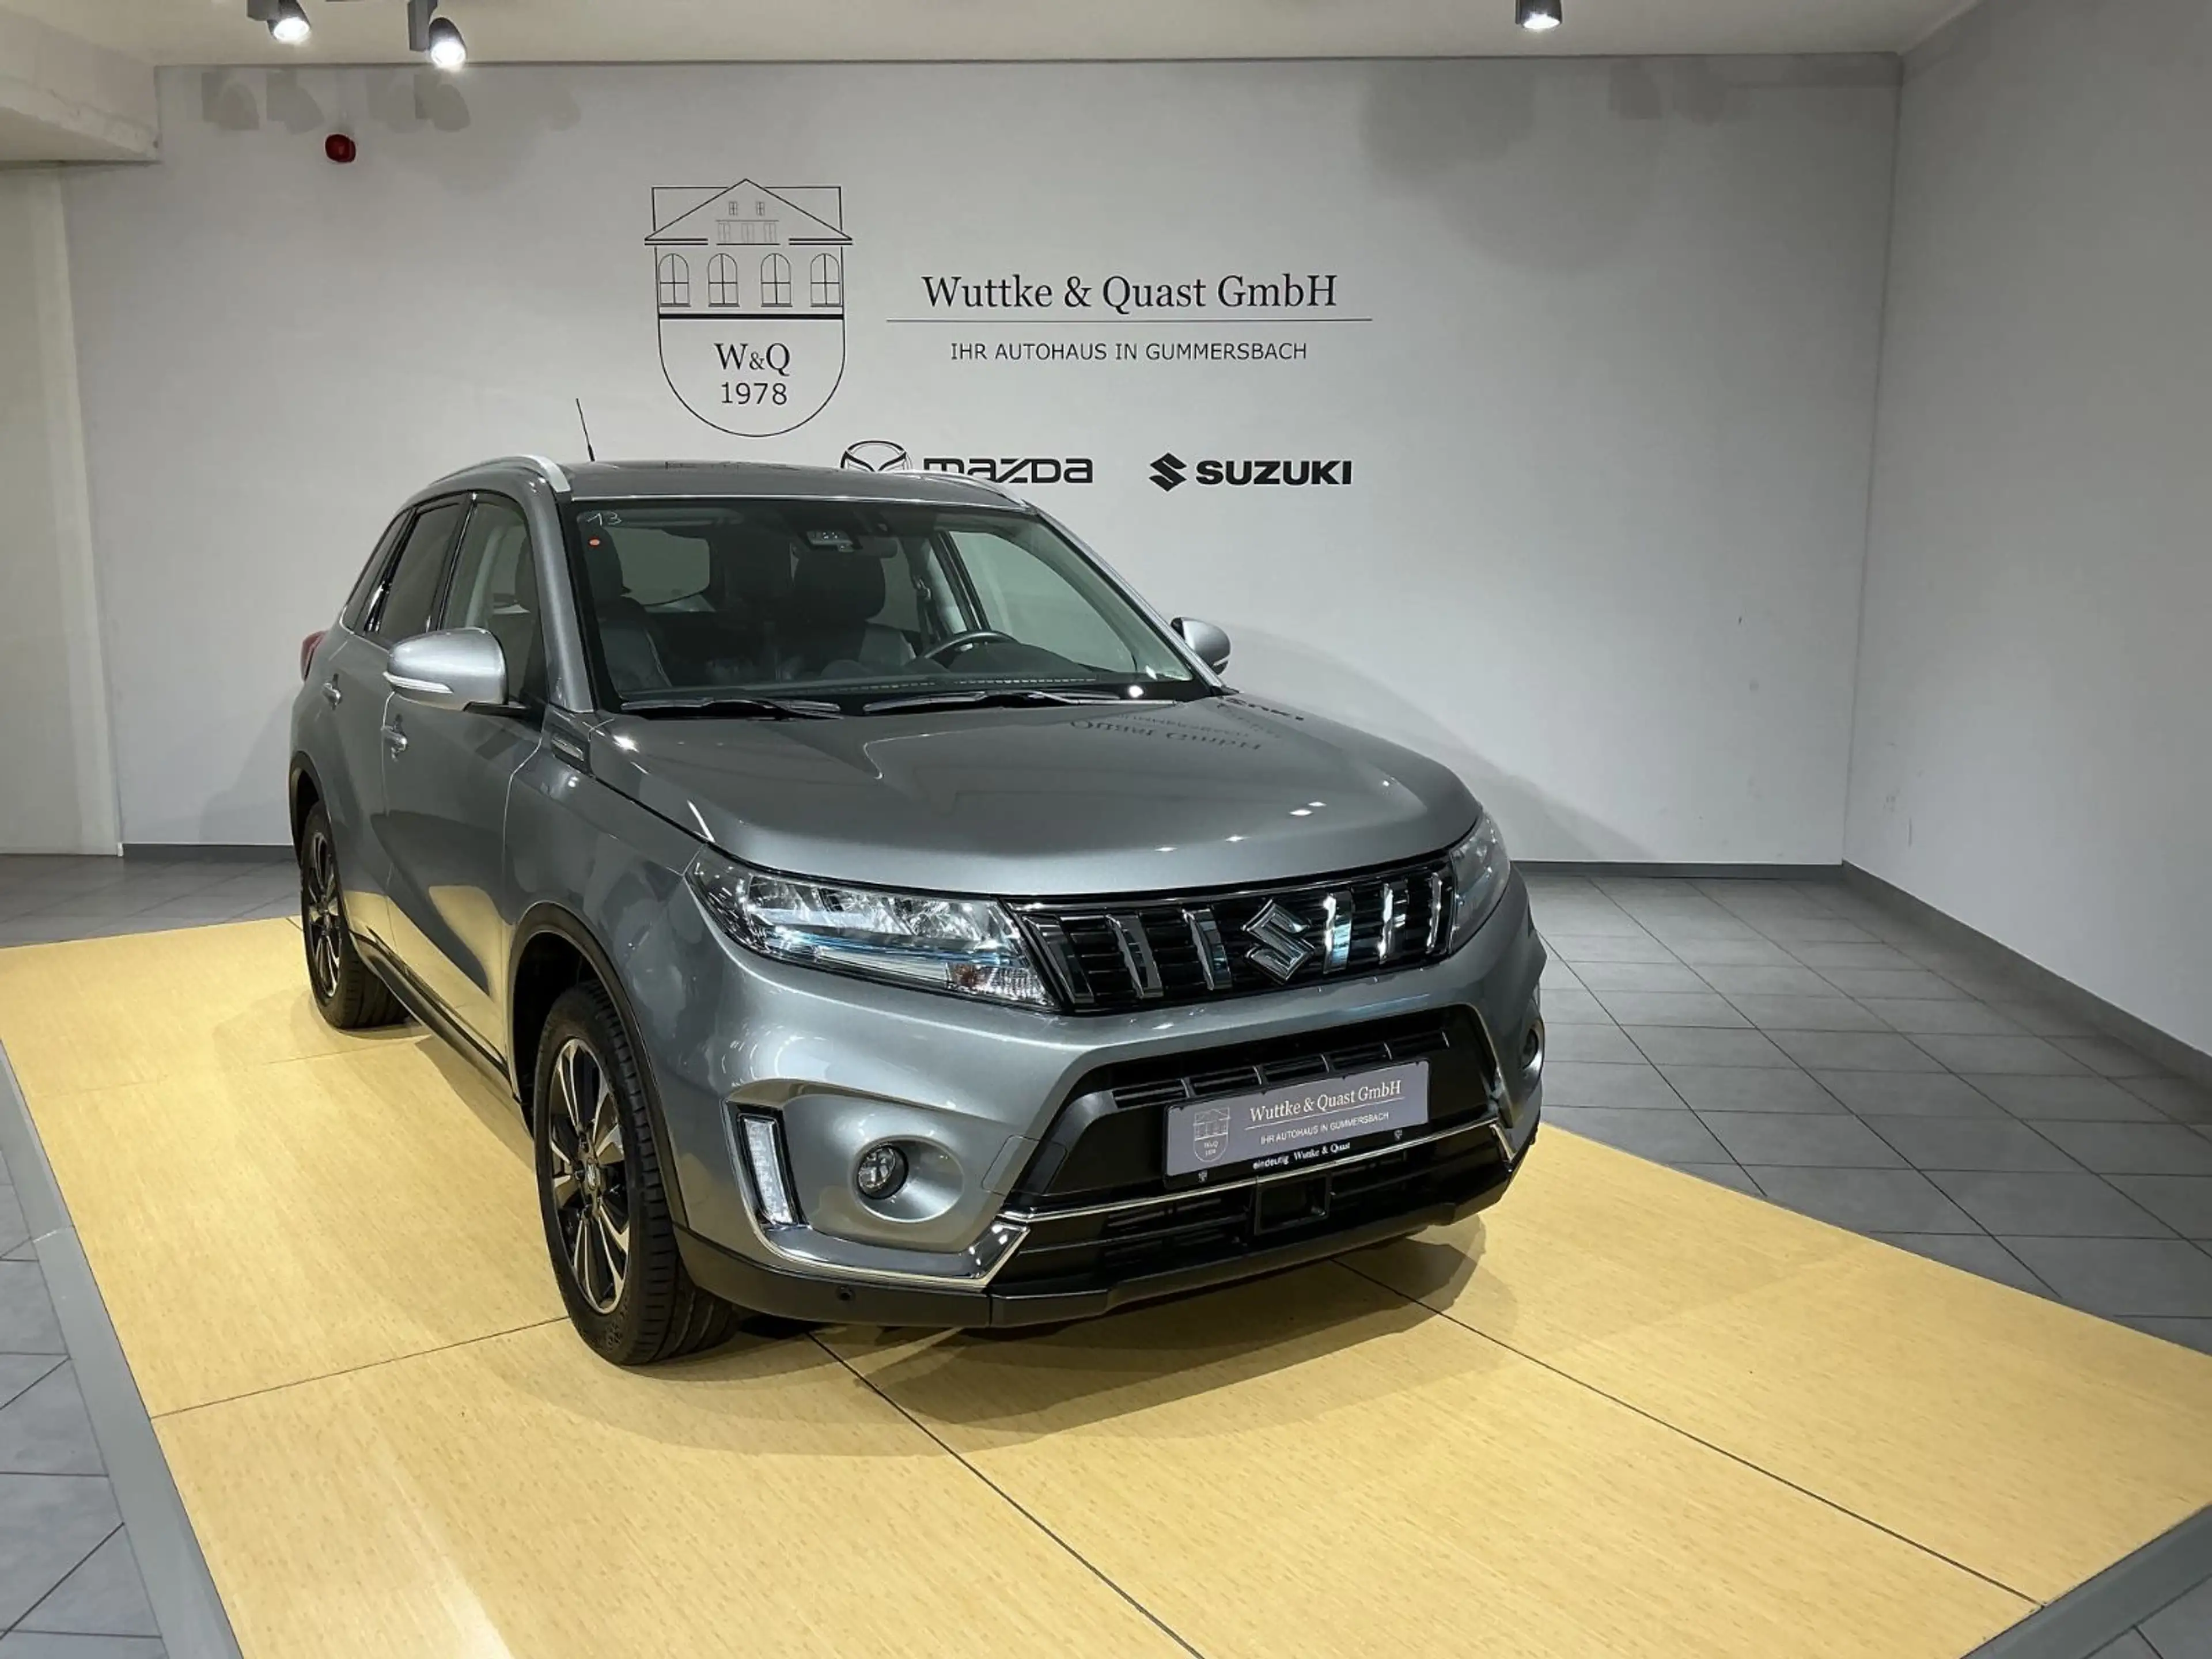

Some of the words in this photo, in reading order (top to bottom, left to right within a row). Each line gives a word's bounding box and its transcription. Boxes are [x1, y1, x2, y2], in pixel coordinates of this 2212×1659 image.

[921, 274, 1052, 308] Wuttke
[1065, 276, 1093, 308] &
[1103, 276, 1206, 315] Quast
[1218, 273, 1338, 308] GmbH
[714, 343, 790, 377] W&Q
[951, 343, 988, 360] IHR
[995, 343, 1107, 361] AUTOHAUS
[1115, 343, 1137, 361] IN
[1146, 343, 1306, 361] GUMMERSBACH
[722, 381, 787, 406] 1978
[1196, 460, 1352, 486] SUZUKI
[1250, 1100, 1301, 1123] Wuttke
[1304, 1097, 1315, 1113] &
[1317, 1091, 1355, 1111] Quast
[1358, 1080, 1402, 1101] GmbH
[1260, 1134, 1274, 1146] IHR
[1275, 1126, 1319, 1142] AUTOHAUS
[1320, 1123, 1328, 1132] IN
[1330, 1112, 1389, 1130] GUMMERSBACH
